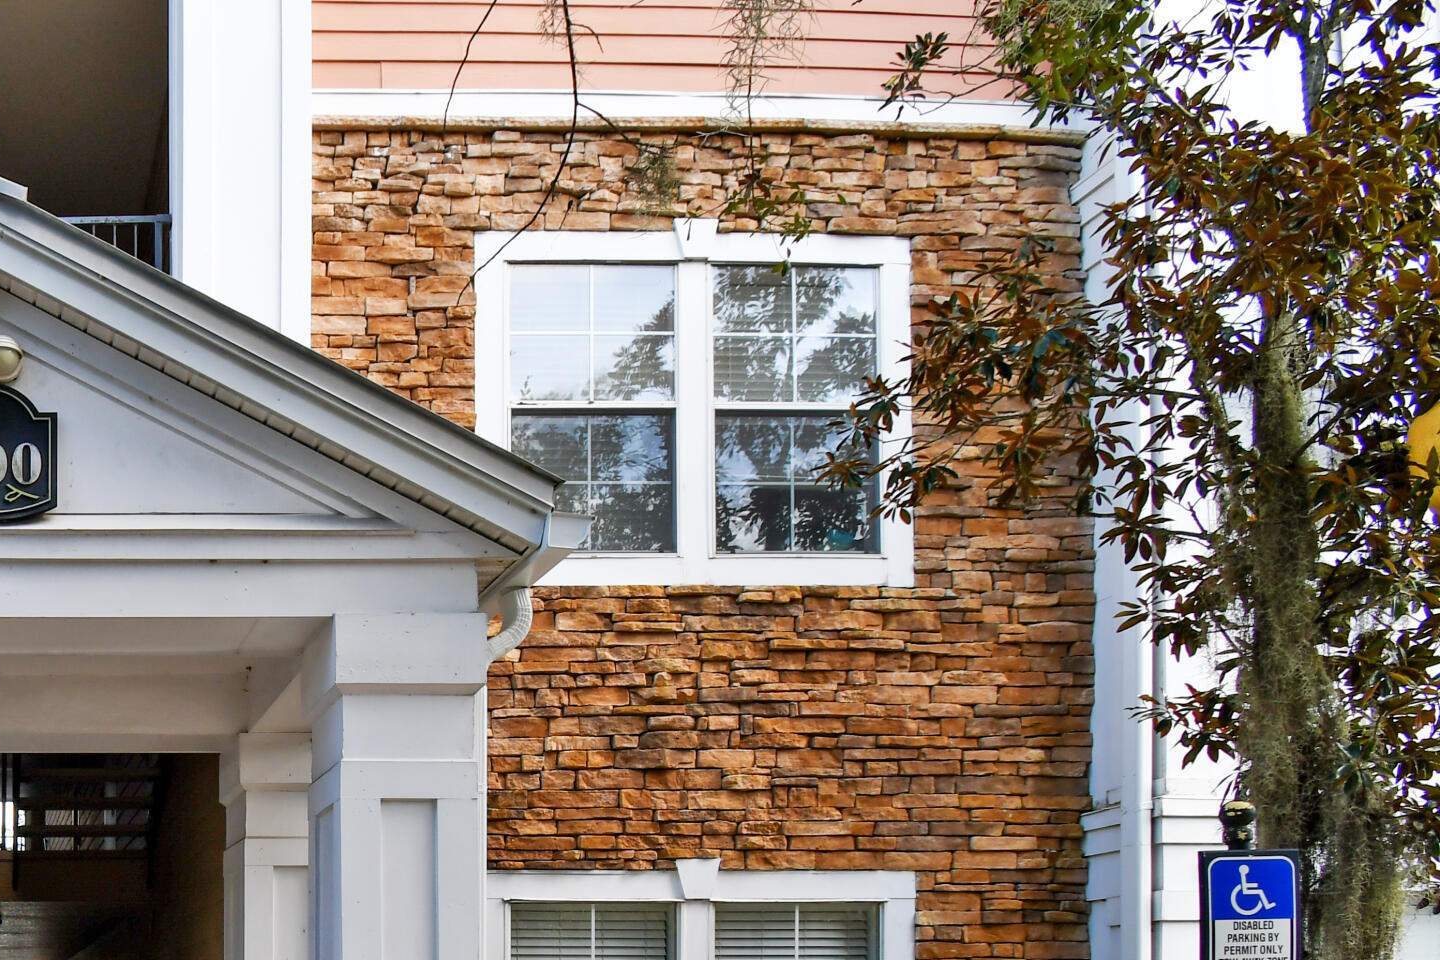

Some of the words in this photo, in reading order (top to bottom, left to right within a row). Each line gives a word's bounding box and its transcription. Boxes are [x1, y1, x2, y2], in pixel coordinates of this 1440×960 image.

[1233, 920, 1274, 930] DISABLED
[1228, 932, 1266, 942] PARKING
[1268, 932, 1279, 942] BY
[1224, 946, 1258, 955] PERMIT
[1260, 945, 1283, 954] ONLY
